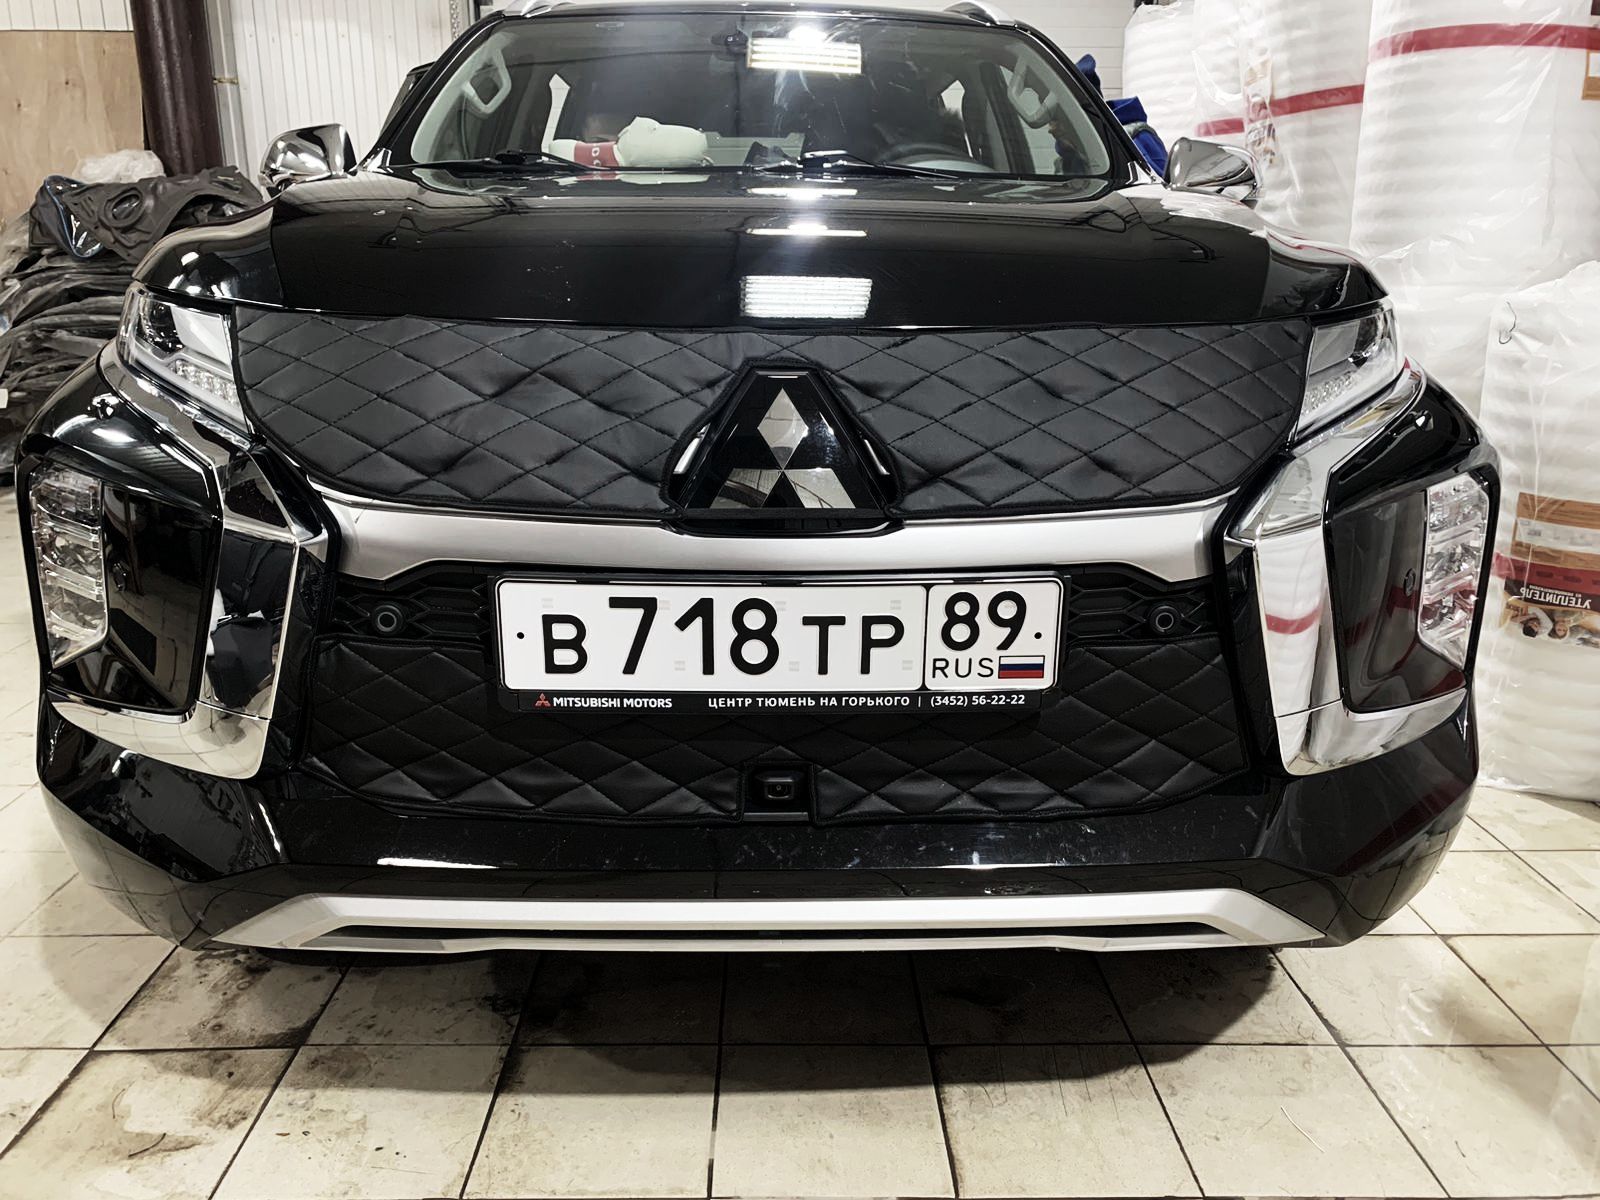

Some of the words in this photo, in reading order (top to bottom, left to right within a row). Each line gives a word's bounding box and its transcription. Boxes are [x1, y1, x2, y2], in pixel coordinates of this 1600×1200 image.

[1520, 587, 1592, 609] УТЕПЛИТЕЛЬ
[940, 591, 1027, 651] 89
[932, 657, 994, 679] RUS
[552, 697, 621, 708] MITSUBISHI
[622, 697, 673, 708] MOTORS
[708, 697, 753, 709] ЦЕНТР
[755, 696, 816, 707] ТЮМЕНЬ
[820, 696, 838, 707] НА
[841, 696, 910, 707] ГОРЬКОГО
[930, 695, 968, 708] (3452)
[971, 694, 1025, 706] 56-22-22
